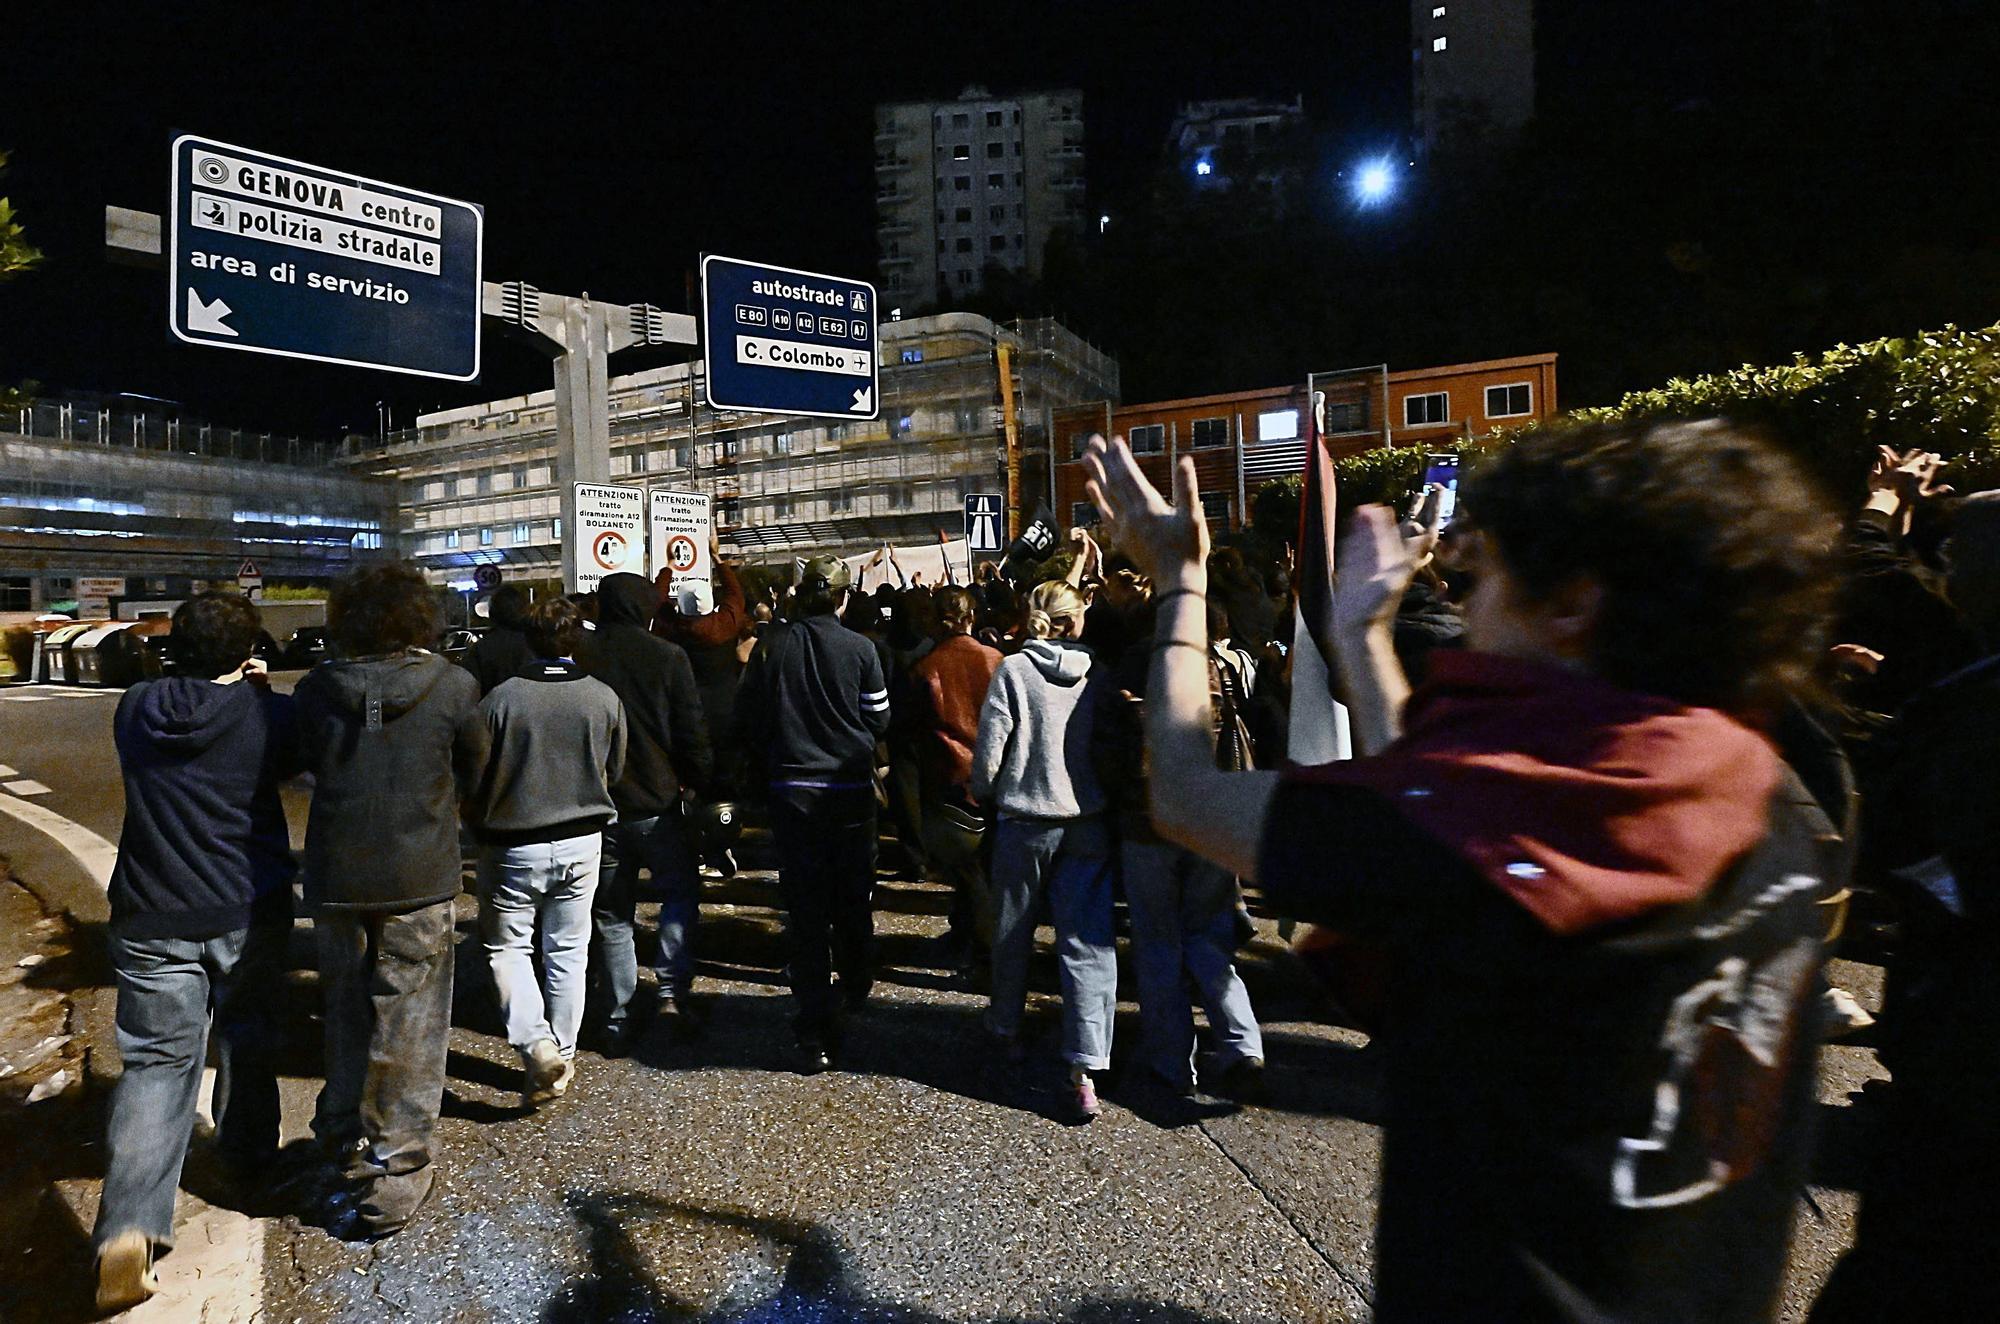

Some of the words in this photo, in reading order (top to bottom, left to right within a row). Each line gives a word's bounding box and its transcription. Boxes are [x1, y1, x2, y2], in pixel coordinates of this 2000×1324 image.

[238, 167, 344, 211] GENOVA
[361, 202, 436, 232] centro
[239, 211, 323, 244] polizia
[337, 230, 434, 266] stradale
[191, 250, 257, 277] area
[269, 262, 295, 285] di
[307, 272, 409, 304] servizio
[753, 281, 844, 306] autostrade
[740, 309, 746, 319] E
[749, 311, 763, 321] 80
[823, 322, 829, 332] E
[830, 322, 843, 334] 62
[854, 325, 865, 336] A7
[745, 342, 763, 359] C.
[769, 345, 845, 368] Colombo
[580, 489, 639, 501] ATTENZIONE
[654, 495, 707, 506] ATTENZIONE
[599, 501, 622, 509] tratto
[671, 507, 691, 515] tratto
[579, 510, 624, 519] diramazione
[654, 515, 693, 524] diramazione
[586, 520, 634, 529] BOLZANETO
[665, 526, 697, 534] aeroporto
[601, 542, 609, 555] 4
[481, 570, 497, 584] 50
